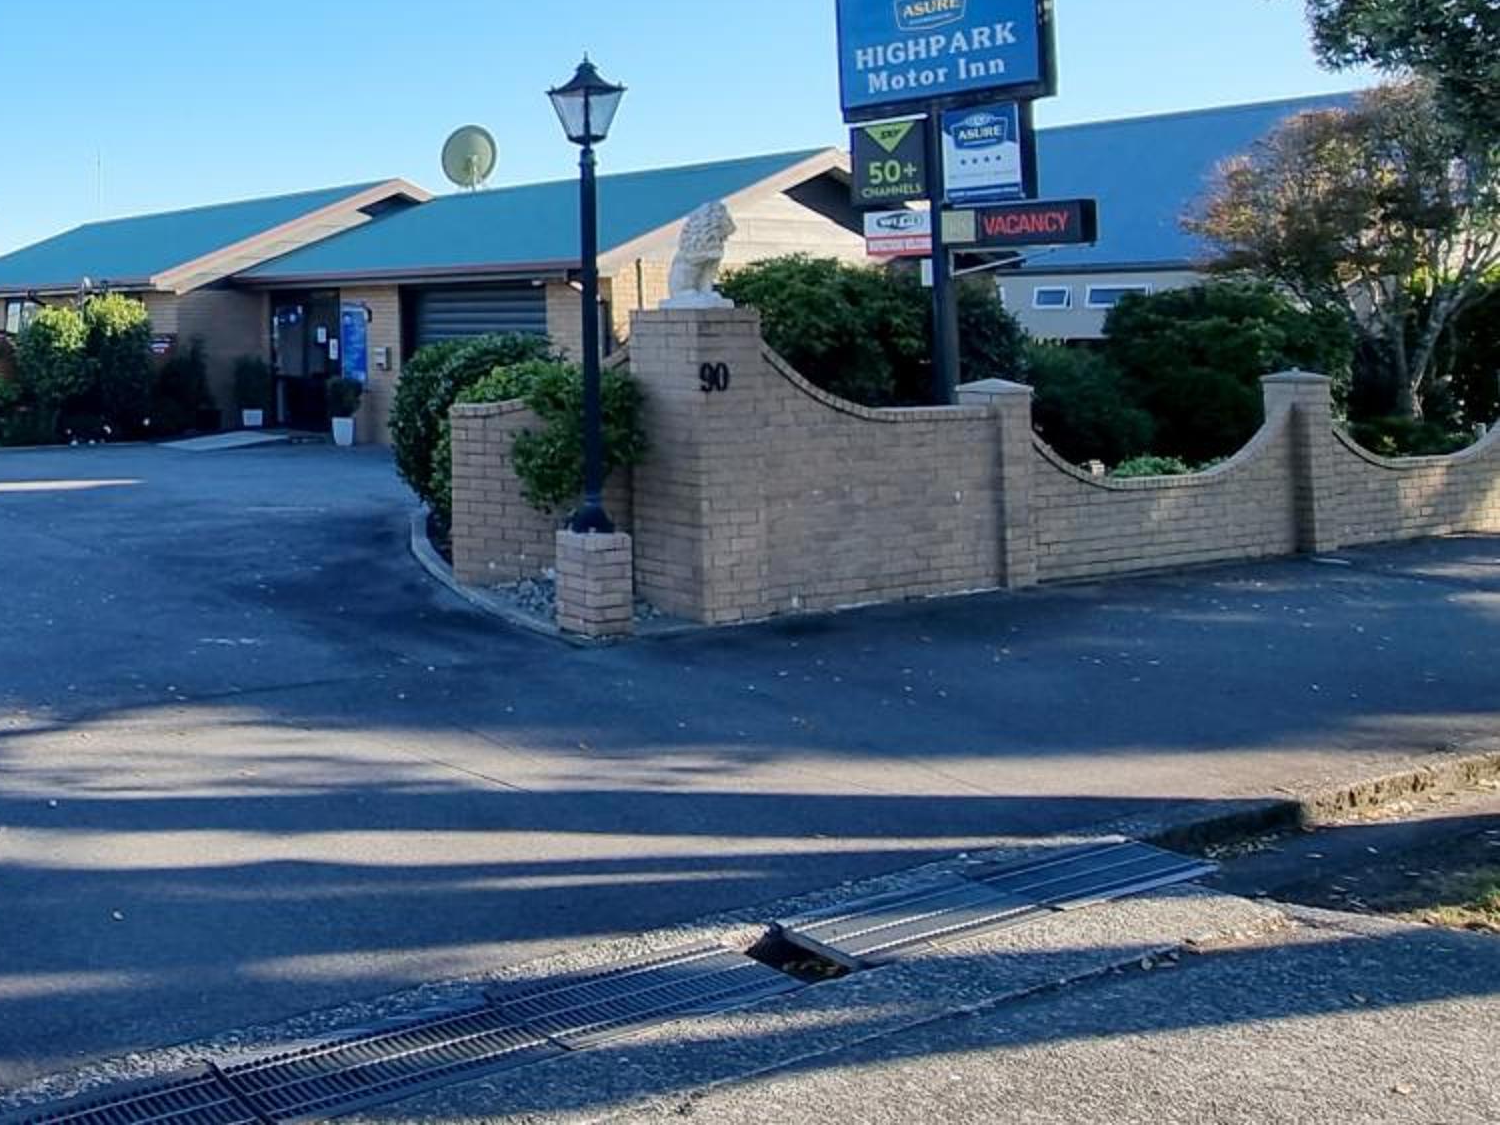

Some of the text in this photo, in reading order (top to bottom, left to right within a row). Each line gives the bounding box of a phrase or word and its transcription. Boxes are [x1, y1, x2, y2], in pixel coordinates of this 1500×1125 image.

[855, 22, 1016, 70] HIGHPARK
[868, 58, 1005, 93] Motor Inn
[958, 125, 1002, 140] ASURE
[869, 160, 916, 184] 50+
[862, 183, 921, 198] CHANNELS
[984, 210, 1068, 235] VACANCY
[700, 362, 729, 393] 90
